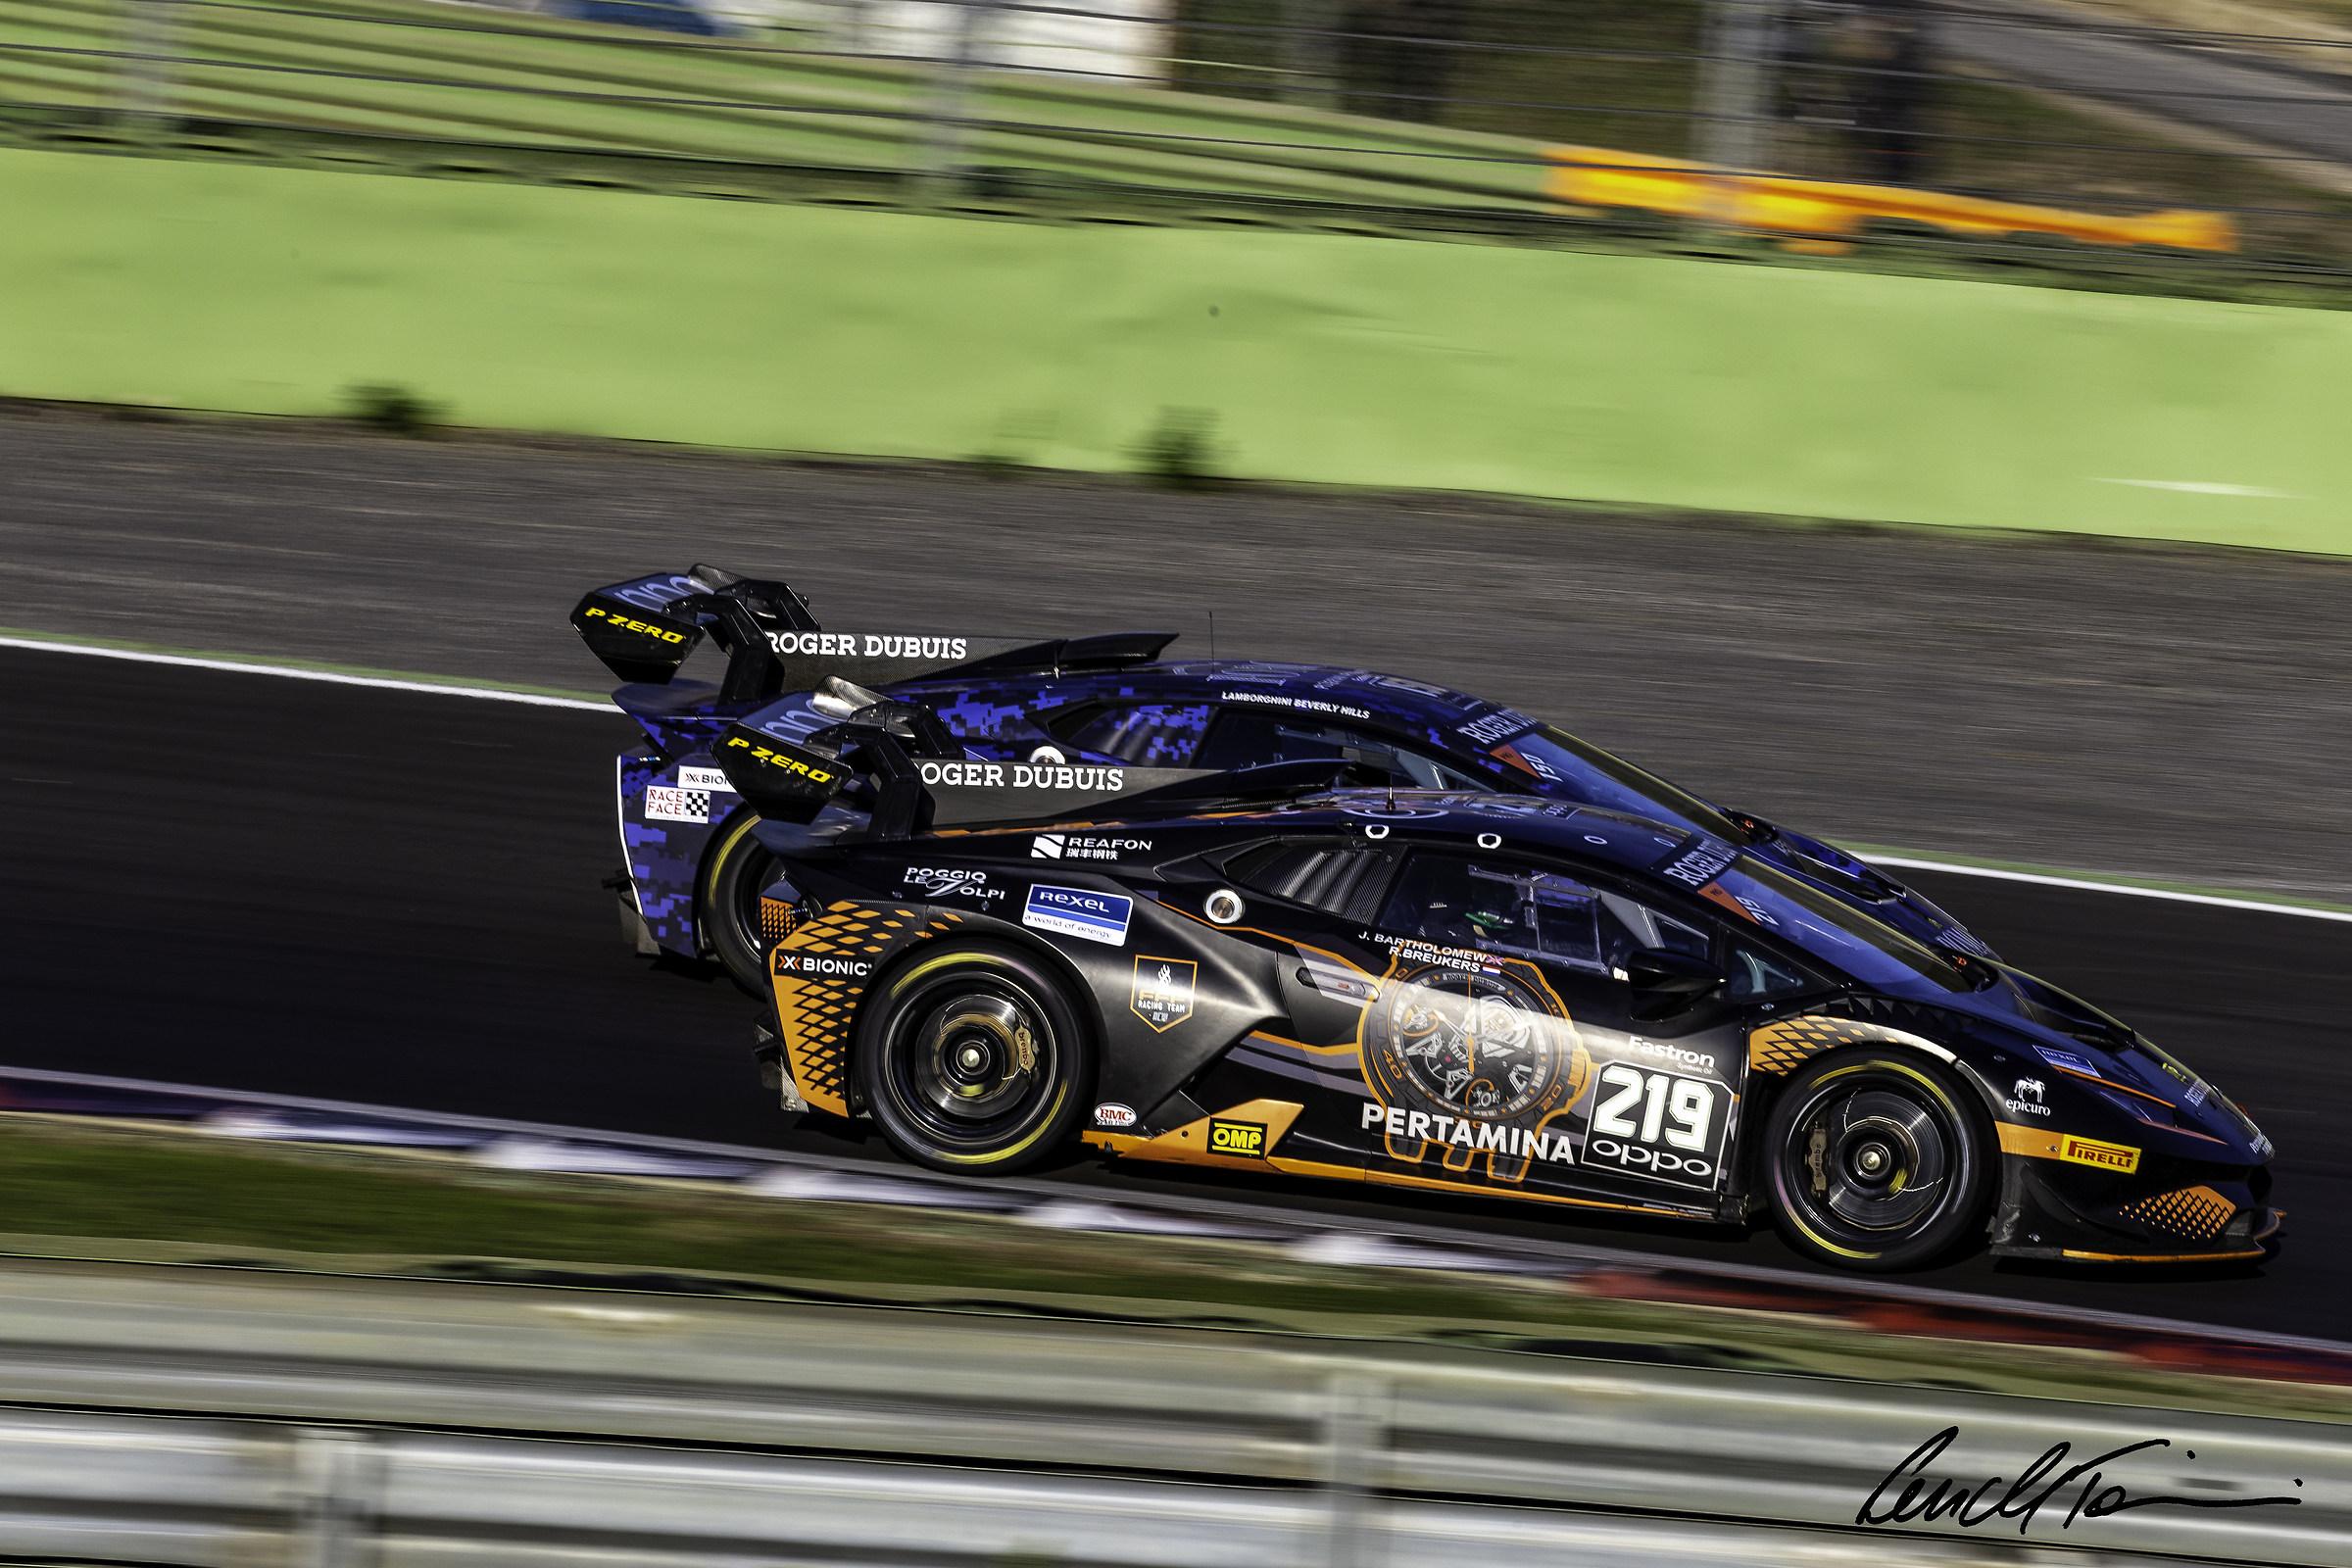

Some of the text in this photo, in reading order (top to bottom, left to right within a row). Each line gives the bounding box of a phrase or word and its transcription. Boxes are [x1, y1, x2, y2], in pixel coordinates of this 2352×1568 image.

[585, 607, 684, 644] P ZERO
[864, 636, 967, 660] DUBUIS
[1221, 691, 1371, 719] LAMBORGHINI BEVERLY HILLS
[728, 737, 831, 783] P ZERO
[914, 762, 1124, 791] OGER DUBUIS
[648, 802, 682, 815] FACE
[649, 789, 684, 803] RACE
[1069, 837, 1152, 851] REAFON
[906, 866, 986, 881] POGGIO
[1034, 916, 1062, 927] world
[1358, 931, 1488, 963] J. BARTHOLOMEW
[1138, 1000, 1186, 1013] RACING TEAM
[1629, 1035, 1715, 1067] Fastron
[1100, 1107, 1132, 1121] BMC
[1593, 1065, 1715, 1152] 219
[2005, 1098, 2051, 1117] epicuro
[1213, 1128, 1262, 1150] OMP
[1361, 1102, 1575, 1165] PERTAMINA
[1592, 1140, 1712, 1176] oppo
[2067, 1140, 2134, 1168] PIRELLI
